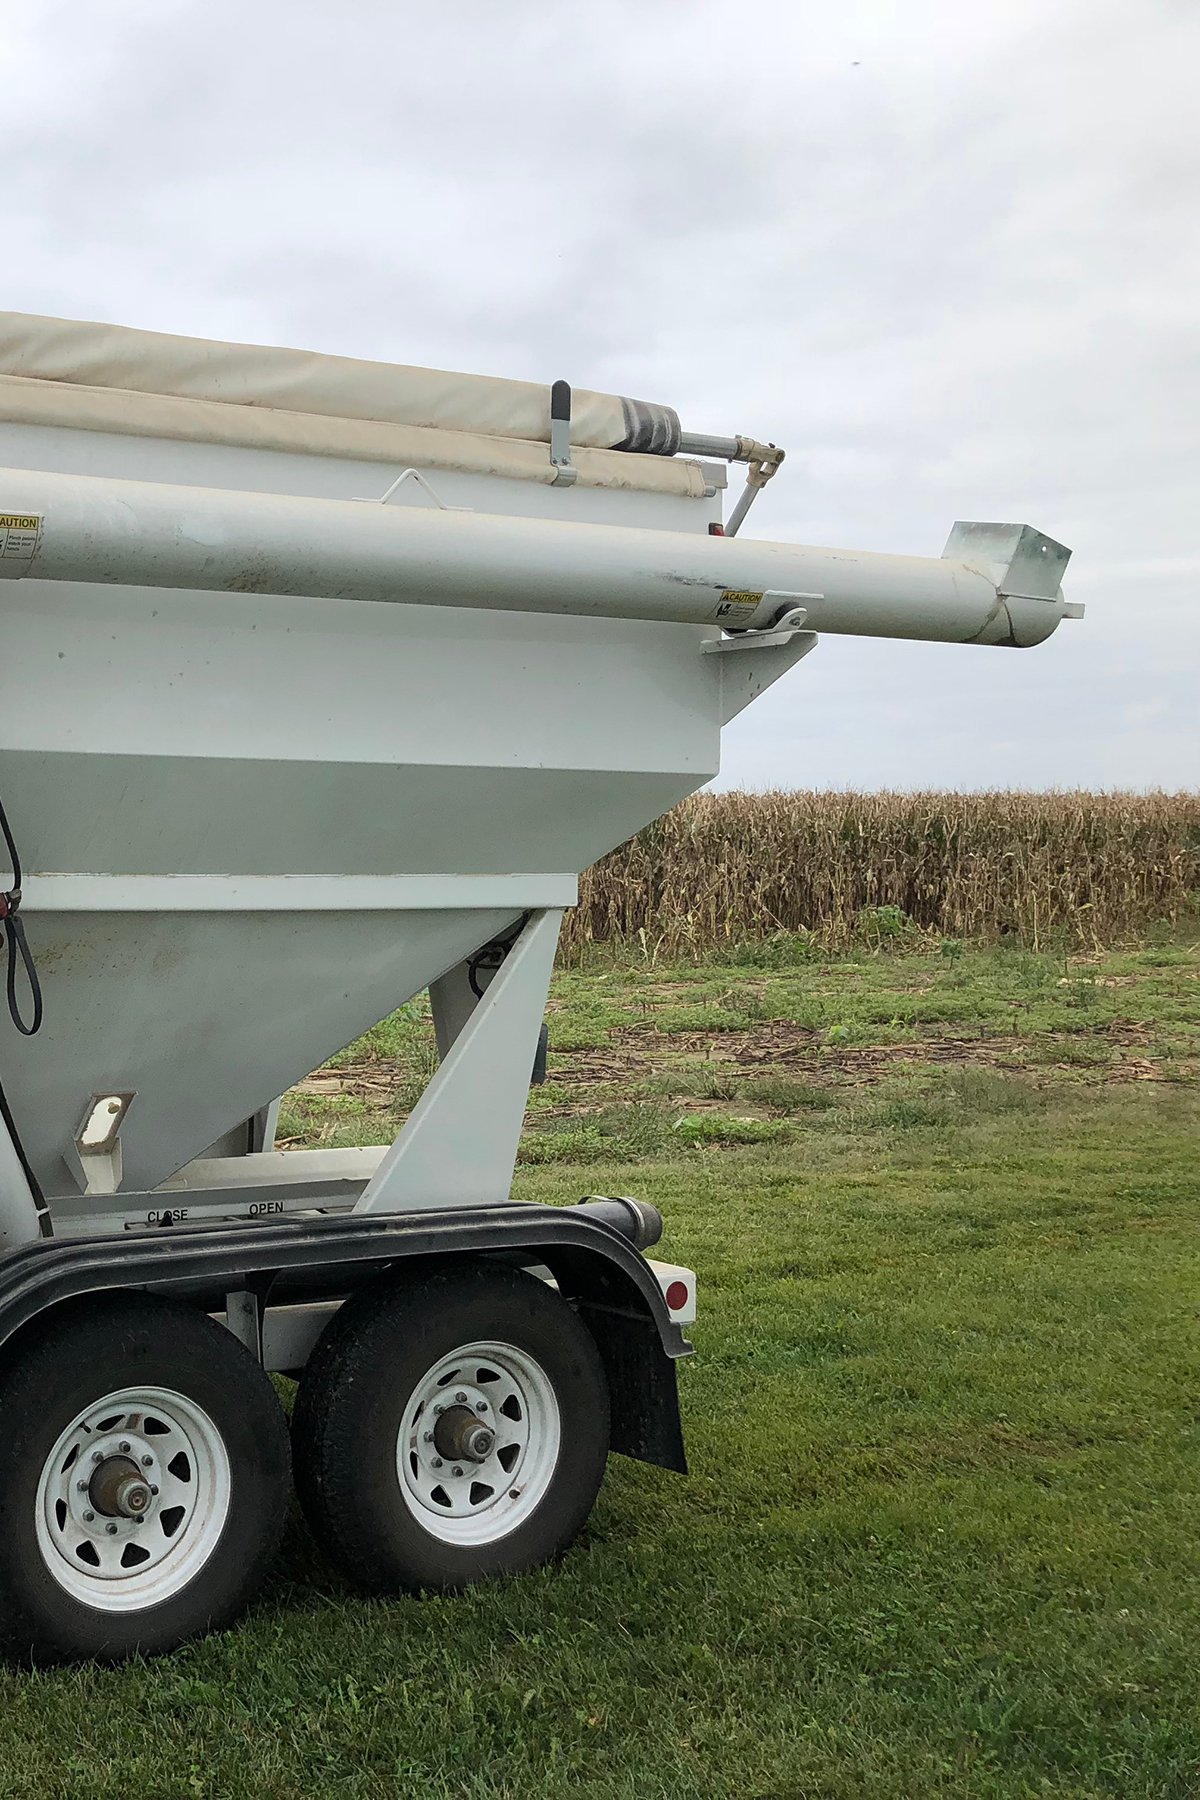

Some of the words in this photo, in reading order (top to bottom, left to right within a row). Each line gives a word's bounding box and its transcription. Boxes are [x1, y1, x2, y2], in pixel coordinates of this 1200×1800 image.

[730, 593, 761, 602] CAUTION
[249, 1201, 284, 1215] OPEN
[147, 1209, 189, 1223] CLOSE
